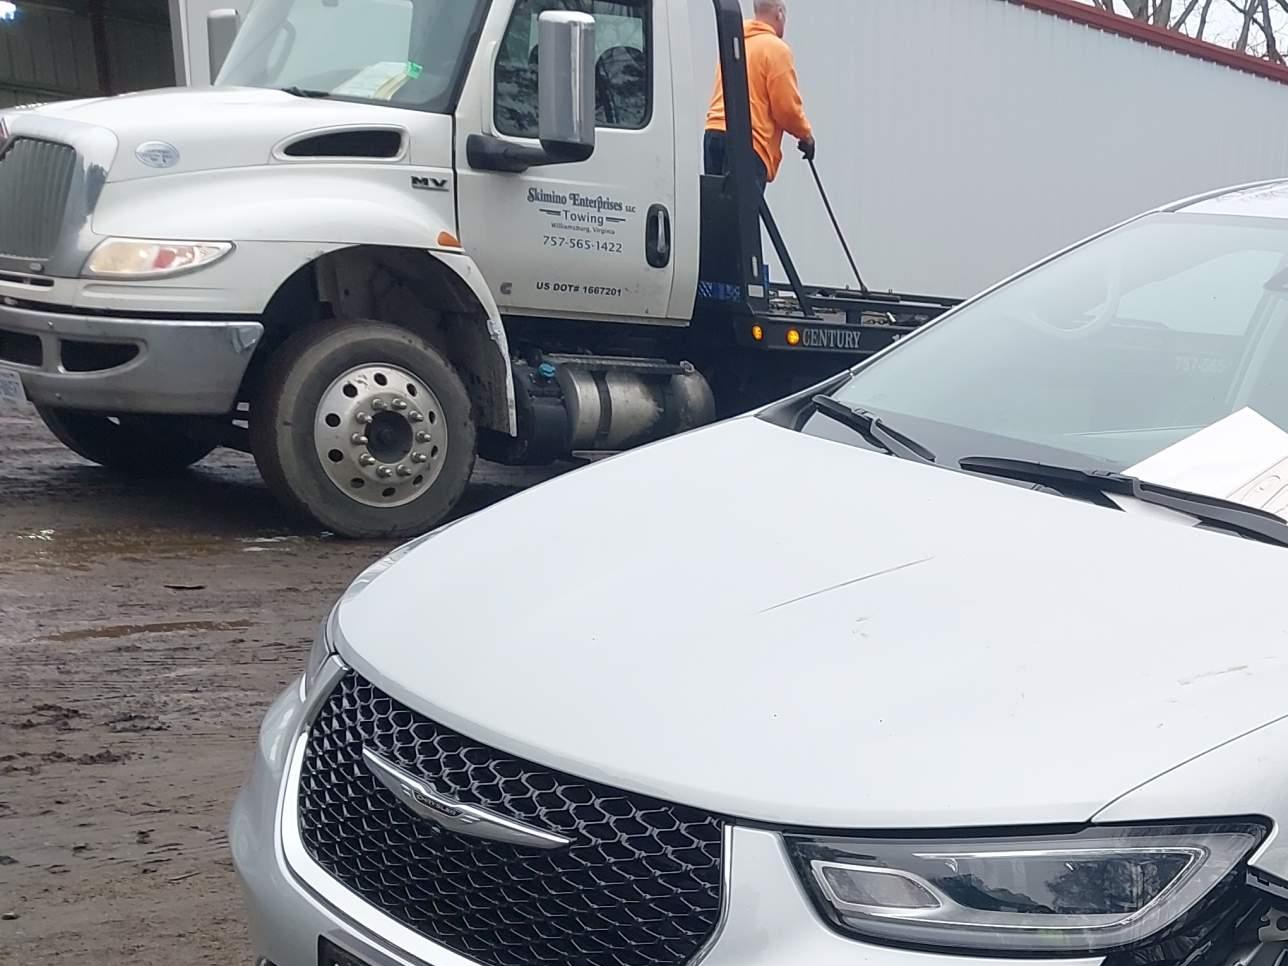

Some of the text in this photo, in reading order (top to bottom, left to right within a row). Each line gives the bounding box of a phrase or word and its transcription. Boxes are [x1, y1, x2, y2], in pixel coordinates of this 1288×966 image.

[411, 176, 448, 188] MV
[527, 187, 567, 205] Skimino
[569, 193, 623, 212] Enterprises
[562, 210, 604, 226] Towing
[543, 236, 622, 253] 757-565-1422
[536, 282, 622, 296] US DOT# 1667201
[802, 329, 861, 348] CENTURY
